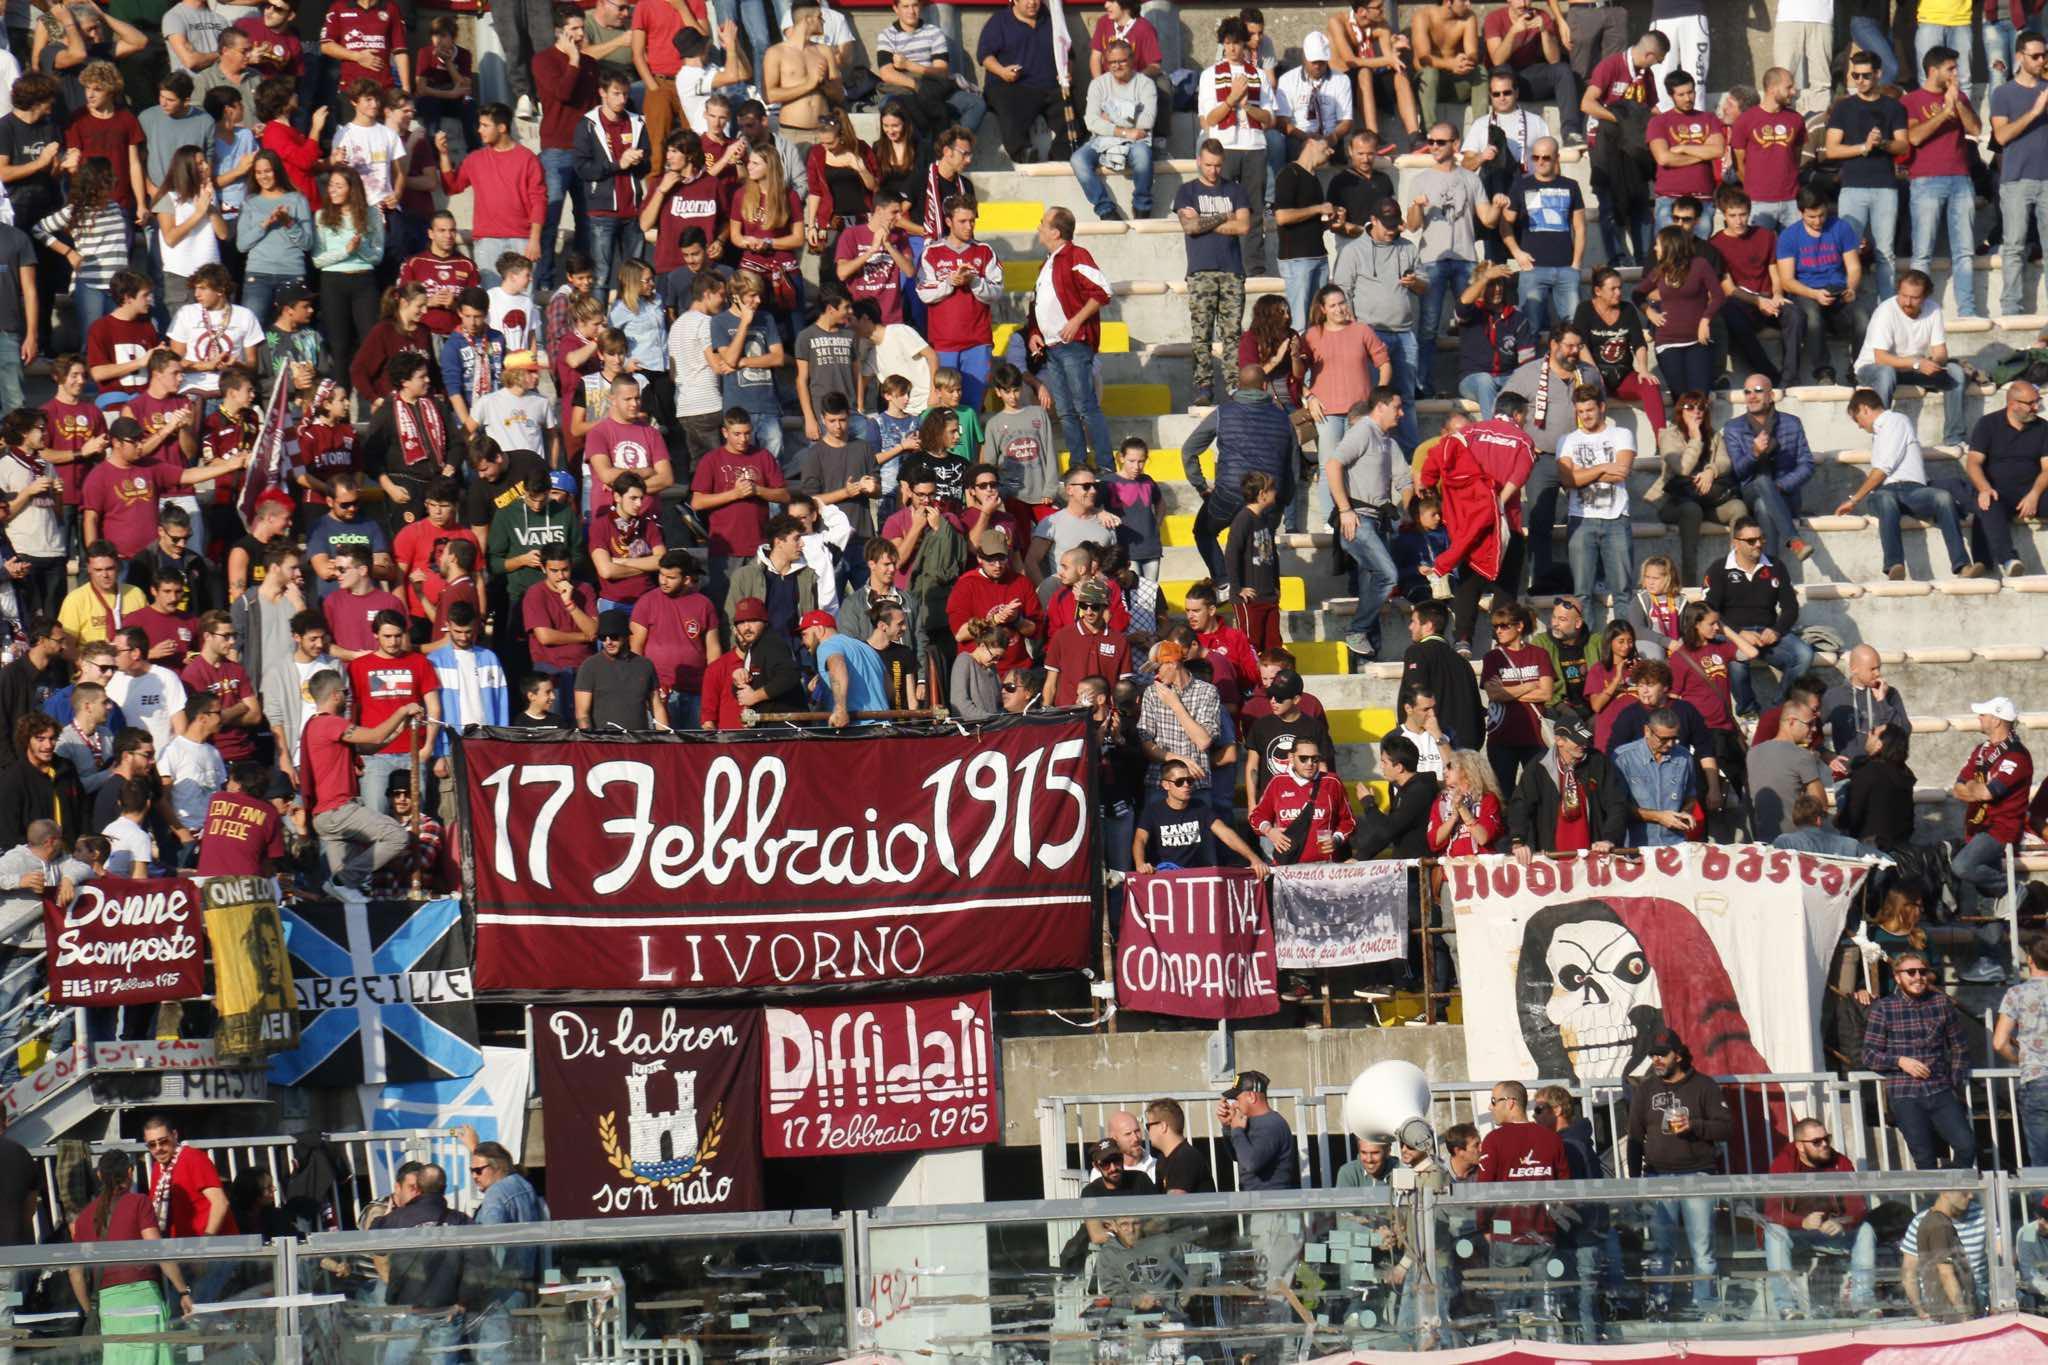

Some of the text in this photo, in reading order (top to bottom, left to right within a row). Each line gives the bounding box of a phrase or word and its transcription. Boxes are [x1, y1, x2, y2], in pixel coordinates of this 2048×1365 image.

[671, 196, 717, 219] Livorno
[329, 533, 370, 544] adidas
[514, 525, 565, 546] VANS
[210, 799, 236, 817] CENT
[480, 738, 1087, 896] 17 Febbraio 1915
[220, 820, 252, 841] FEDE
[1369, 863, 1390, 877] con
[1654, 847, 1682, 878] e
[211, 880, 254, 906] ONE
[63, 884, 190, 931] Donne
[56, 925, 197, 974] Scomposte
[638, 924, 925, 983] LIVORNO
[94, 980, 108, 993] 17
[294, 970, 469, 1010] ARSEILLE
[549, 1006, 738, 1061] Di labron
[782, 1103, 988, 1154] 17 Febbraio 1915
[1508, 1165, 1552, 1178] LEGEA
[592, 1167, 735, 1214] son nato
